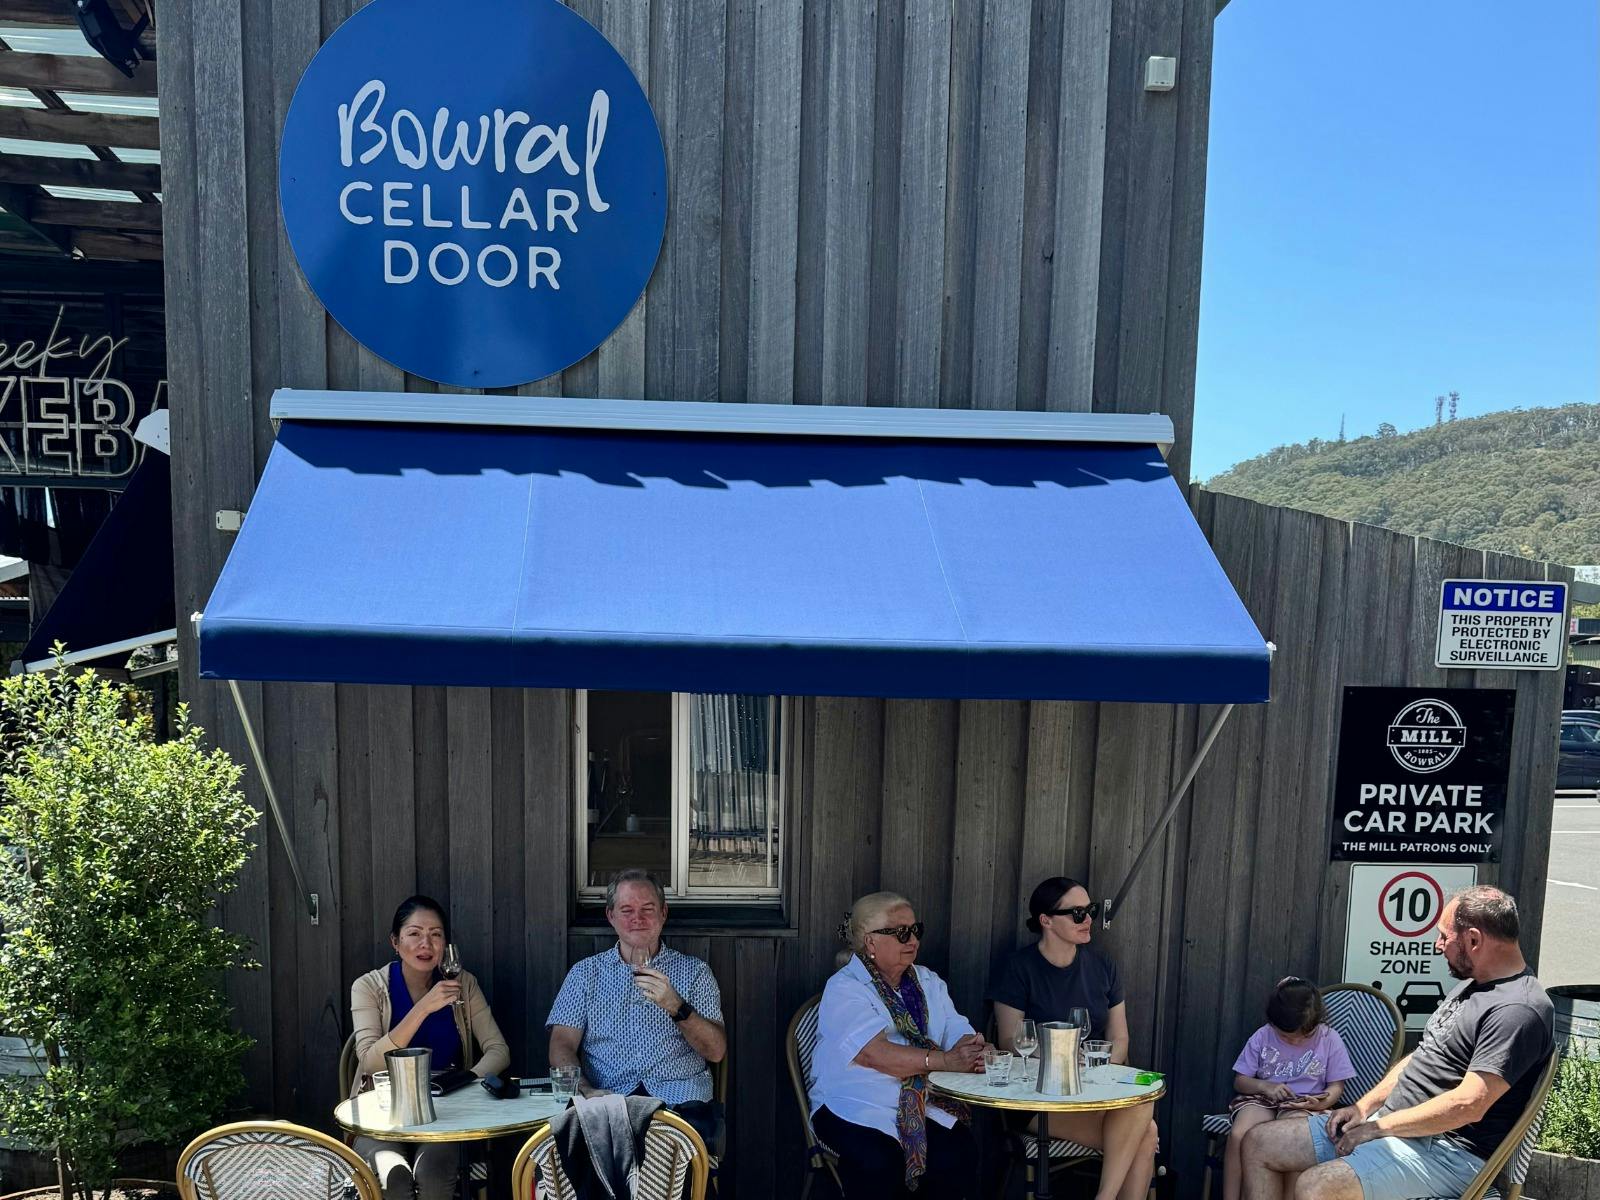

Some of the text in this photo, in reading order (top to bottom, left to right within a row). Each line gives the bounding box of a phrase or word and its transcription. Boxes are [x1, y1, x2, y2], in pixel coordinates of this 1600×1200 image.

[338, 79, 610, 212] Bowral
[340, 181, 579, 233] CELLAR
[384, 240, 562, 290] DOOR
[1453, 588, 1554, 608] NOTICE
[1451, 615, 1554, 627] THIS PROPERTY
[1452, 627, 1550, 639] PROTECTED BY
[1460, 640, 1541, 650] ELECTRONIC
[1450, 651, 1548, 663] SURVEILLANCE
[1416, 707, 1440, 724] The
[1401, 730, 1452, 743] MILL
[1404, 751, 1447, 766] BOWRAL
[1359, 783, 1483, 807] PRIVATE
[1344, 810, 1495, 834] CAR PARK
[1342, 842, 1492, 853] THE MILL PATRONS ONLY
[1388, 888, 1431, 922] 10
[1380, 960, 1431, 974] ZONE
